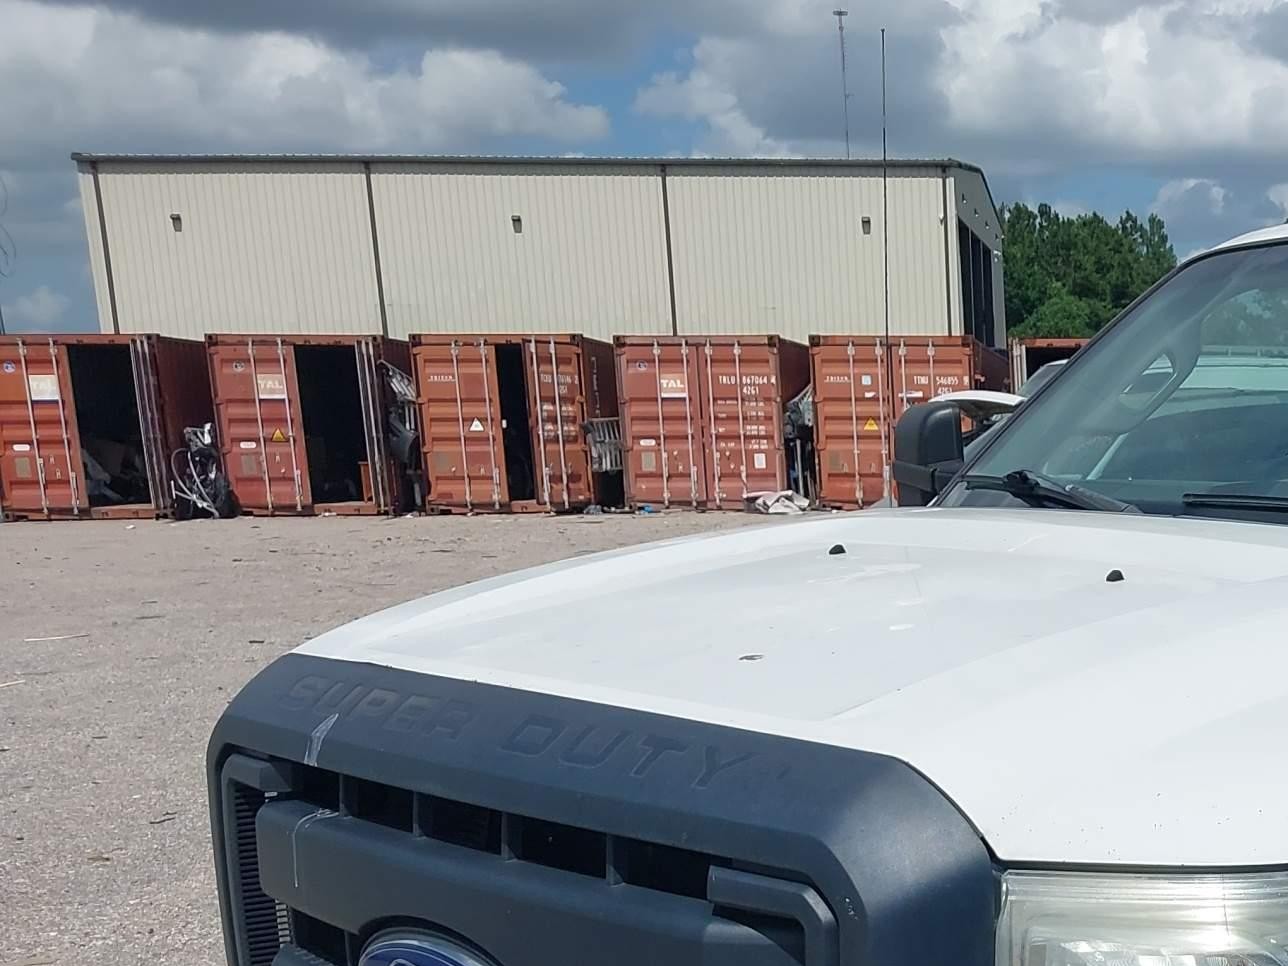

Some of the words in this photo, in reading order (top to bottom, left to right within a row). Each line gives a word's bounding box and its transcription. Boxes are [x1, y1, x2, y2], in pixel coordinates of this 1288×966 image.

[660, 379, 685, 388] TAL
[278, 674, 475, 741] SUPER
[496, 713, 759, 790] DUTY
